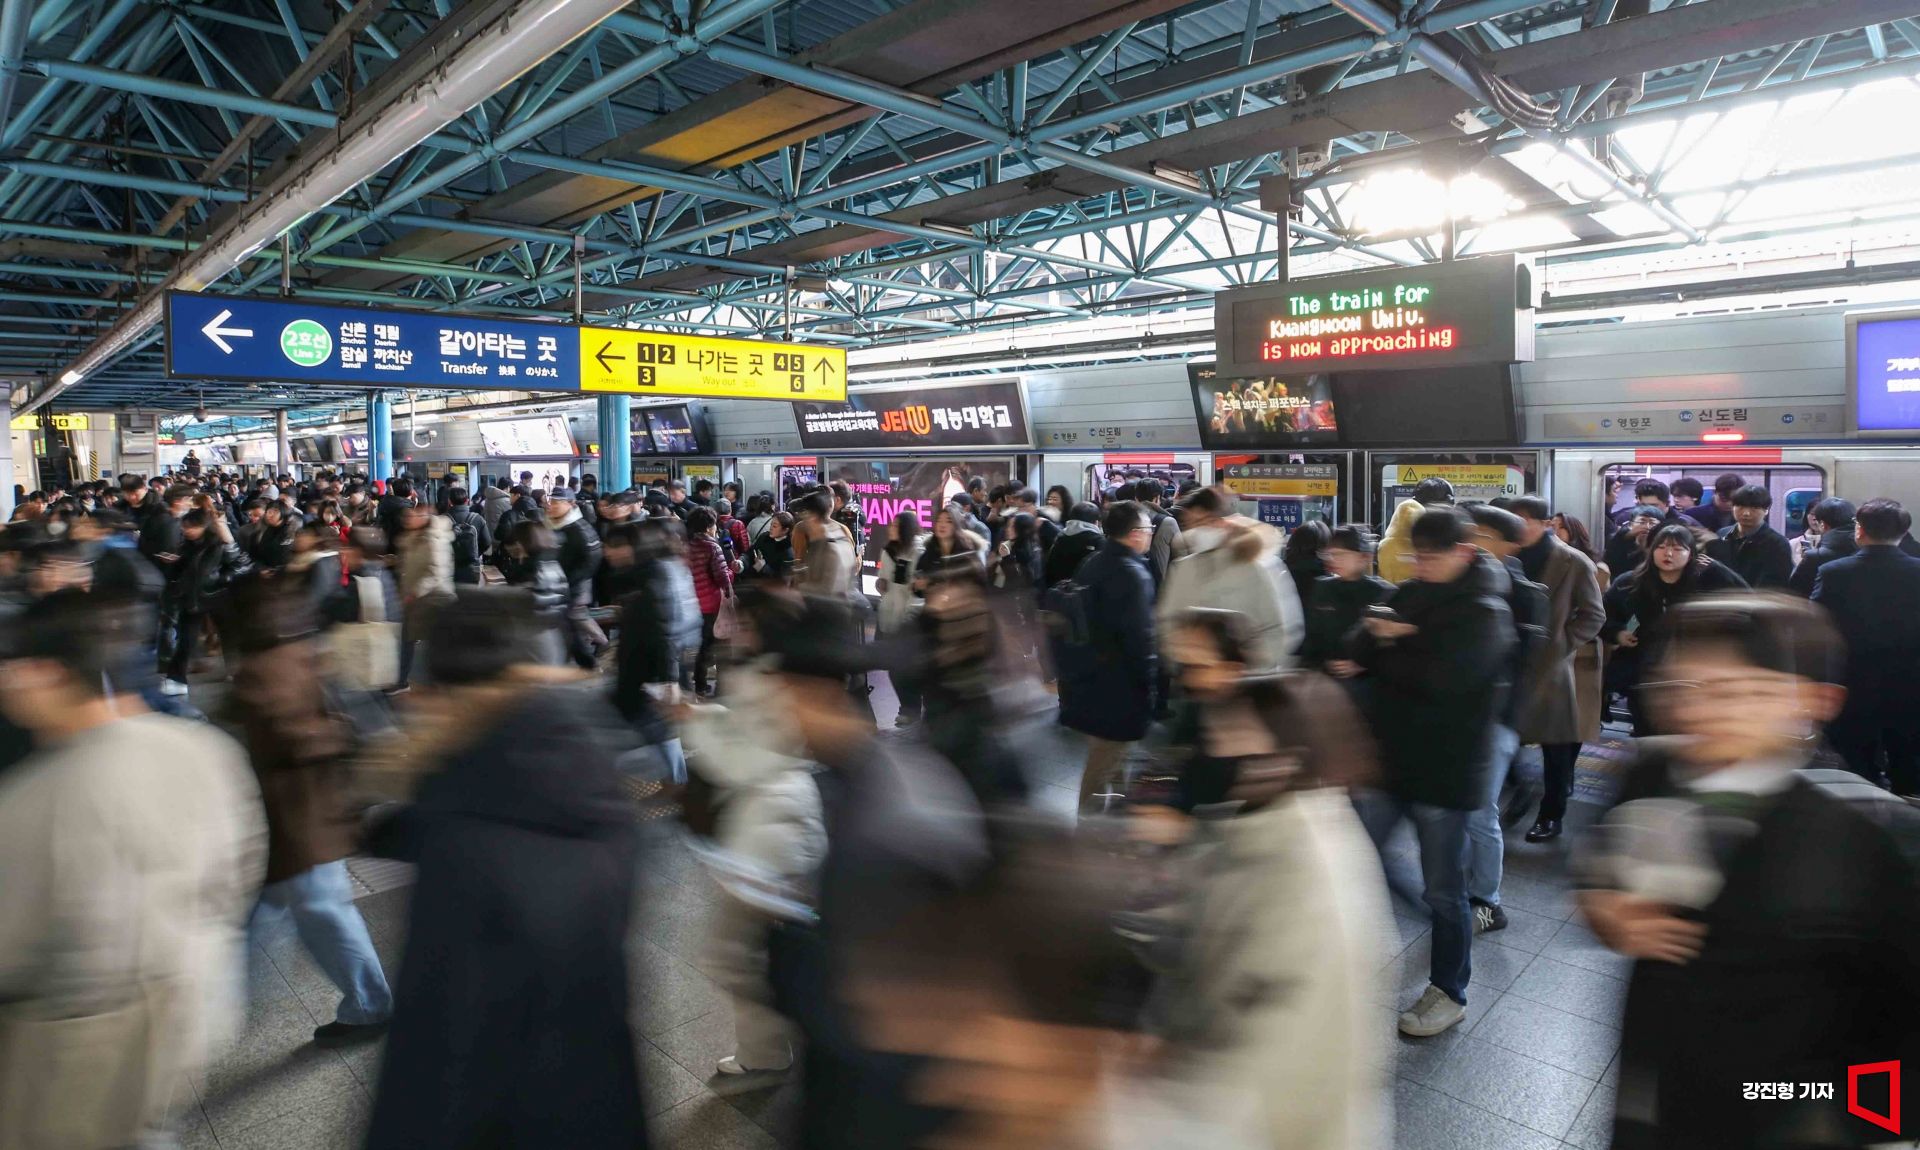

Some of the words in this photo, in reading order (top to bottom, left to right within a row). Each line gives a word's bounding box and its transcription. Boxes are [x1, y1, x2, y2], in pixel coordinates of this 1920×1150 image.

[1290, 296, 1321, 315] The
[1330, 289, 1383, 311] train
[1393, 284, 1430, 304] for
[340, 322, 367, 338] 신촌
[374, 324, 400, 340] 대림
[1270, 315, 1361, 339] Kwangwoon
[1372, 307, 1425, 330] Univ.
[286, 331, 327, 349] 2호선
[439, 329, 526, 360] 갈아타는
[537, 336, 557, 362] 곳
[1263, 342, 1282, 360] is
[1290, 341, 1321, 358] now
[1330, 328, 1452, 356] approaching
[315, 351, 323, 359] 2
[340, 347, 368, 363] 잠실
[374, 348, 413, 365] 까치산
[687, 349, 738, 374] 나가는
[749, 353, 763, 376] 곳
[440, 361, 488, 375] Transfer
[702, 376, 720, 389] Way
[722, 377, 737, 386] out
[1268, 397, 1311, 409] 퍼포먼스
[932, 405, 1012, 431] 재능대학교
[1617, 417, 1652, 428] 영등포
[1699, 408, 1748, 423] 신도림
[1098, 427, 1121, 437] 신도림
[873, 484, 891, 494] 만든다
